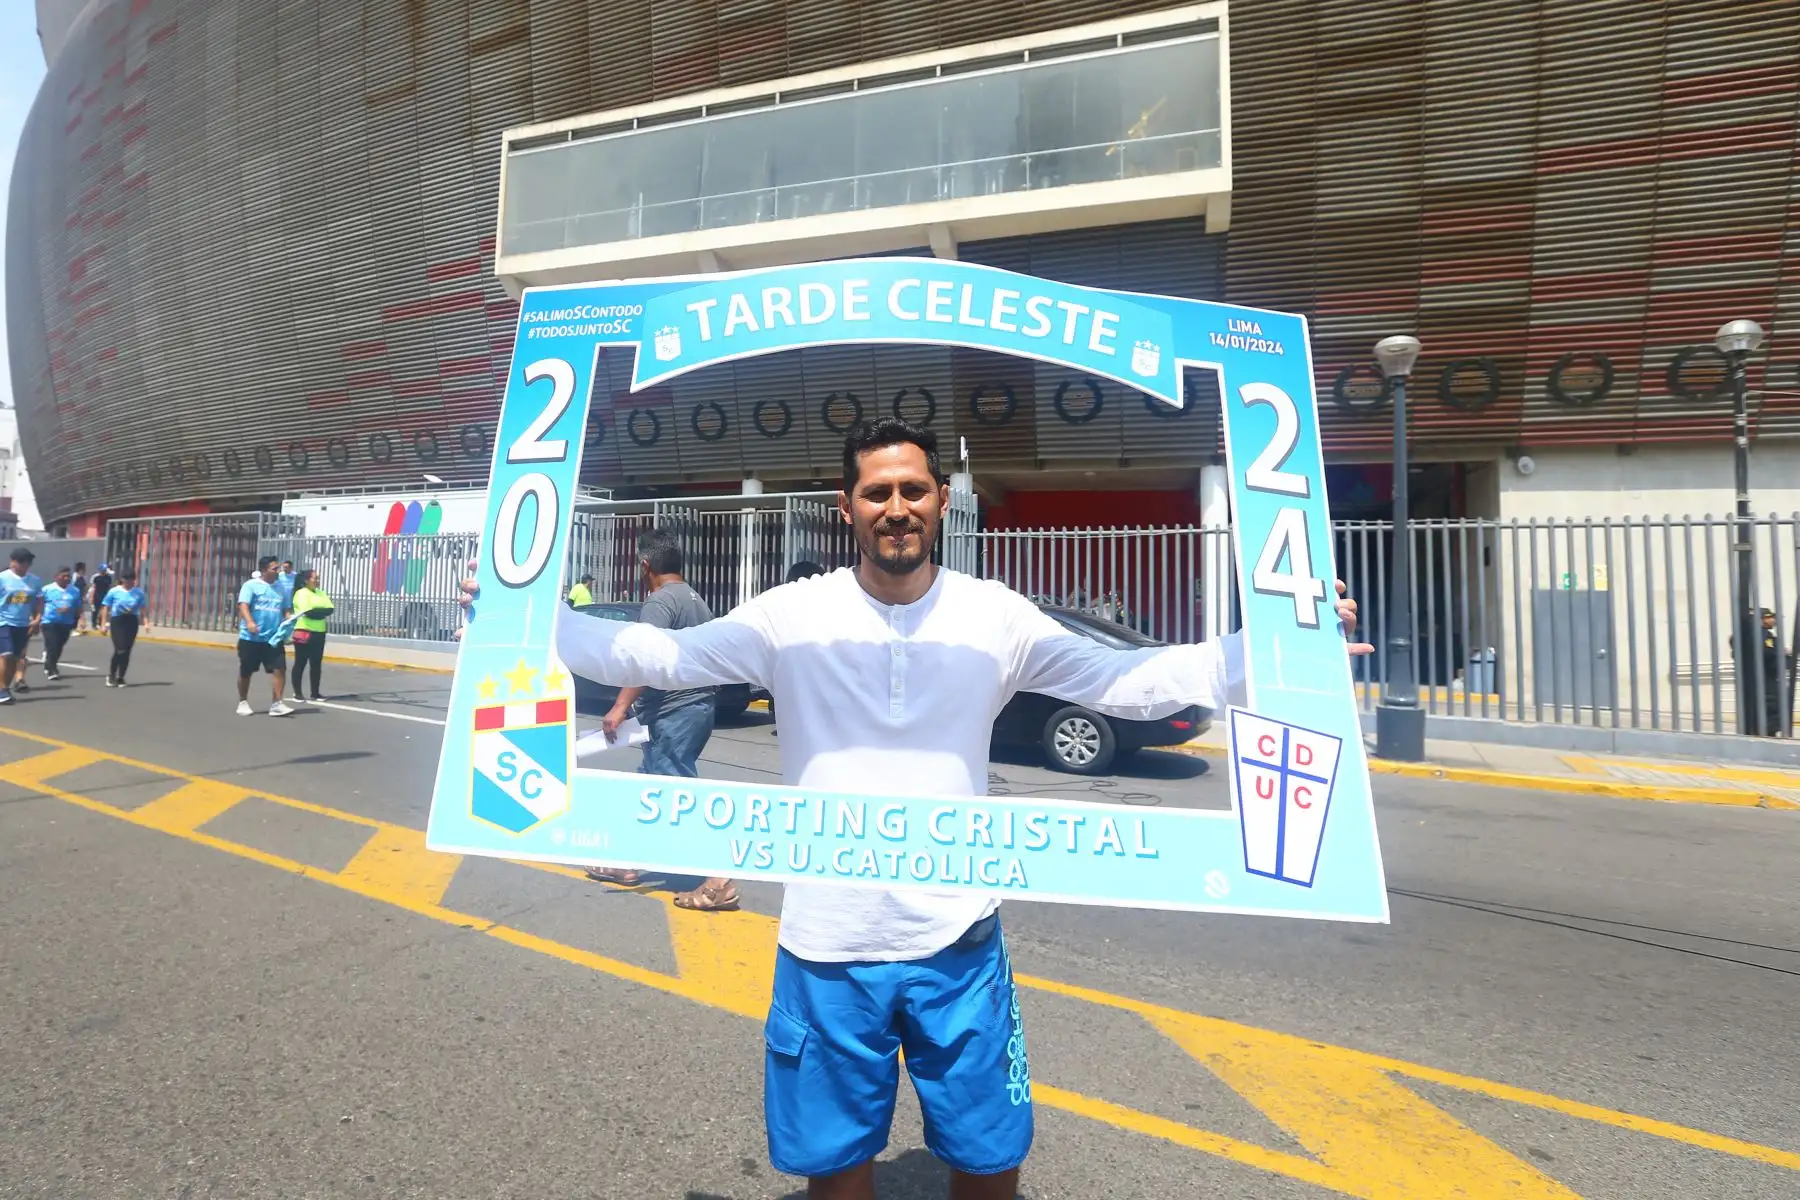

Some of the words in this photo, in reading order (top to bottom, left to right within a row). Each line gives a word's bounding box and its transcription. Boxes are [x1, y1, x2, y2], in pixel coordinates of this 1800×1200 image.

[686, 279, 871, 342] TARDE
[887, 278, 1120, 356] CELESTE
[1228, 318, 1263, 336] LIMA
[1209, 332, 1284, 355] 14/01/2024
[496, 751, 543, 799] SC
[636, 786, 908, 842] SPORTING
[928, 805, 1159, 859] CRISTAL
[729, 838, 774, 868] VS
